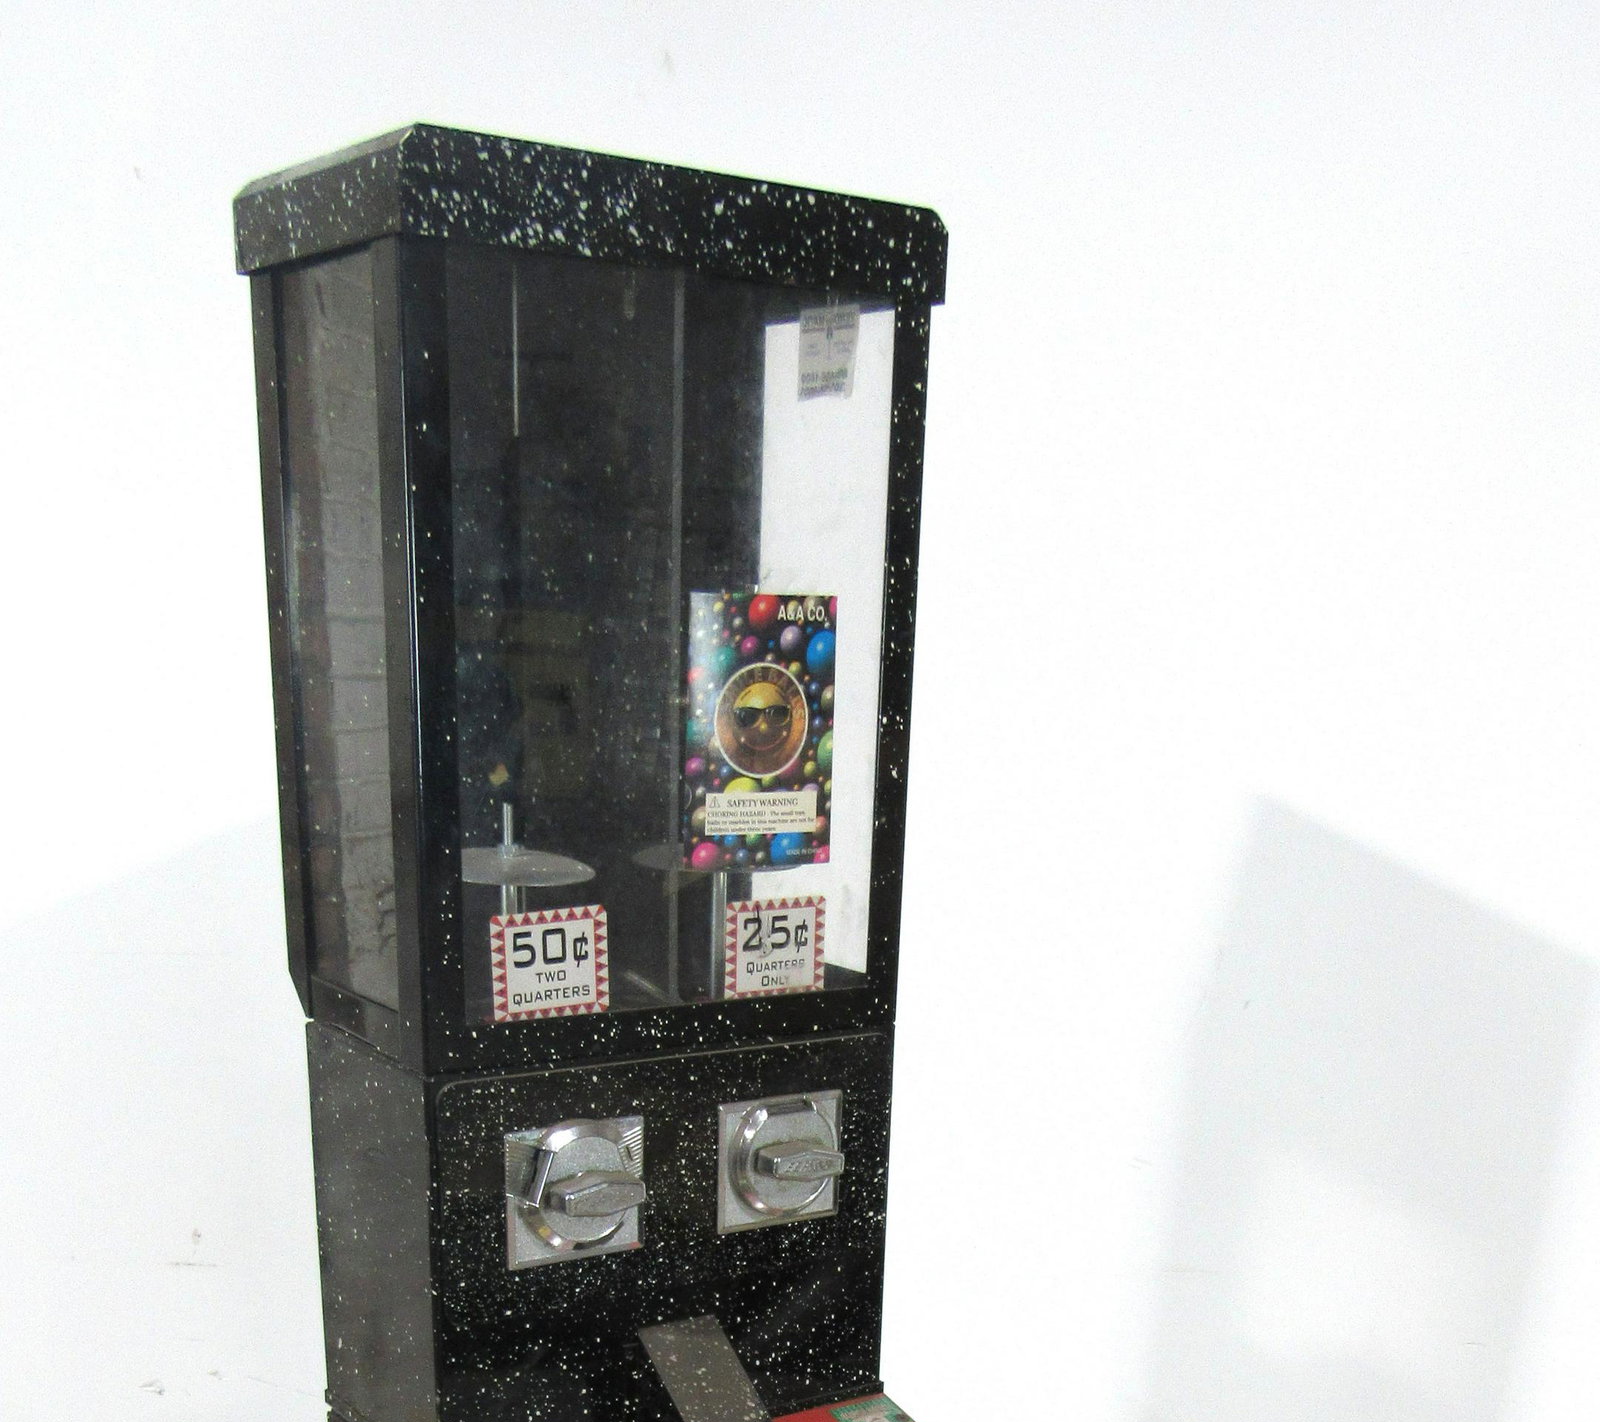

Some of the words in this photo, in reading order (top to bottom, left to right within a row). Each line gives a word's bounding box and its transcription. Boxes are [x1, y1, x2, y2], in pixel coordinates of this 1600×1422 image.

[777, 605, 804, 621] A&A
[807, 606, 828, 621] CO.
[727, 799, 758, 808] SAFETY
[759, 798, 799, 807] WARNING
[707, 810, 739, 818] CHOKING
[742, 914, 809, 953] 25¢
[512, 927, 589, 969] 50¢
[746, 958, 805, 976] QUARTERS
[535, 969, 567, 984] TWO
[761, 975, 790, 987] ONLY
[512, 984, 591, 1006] QUARTERS
